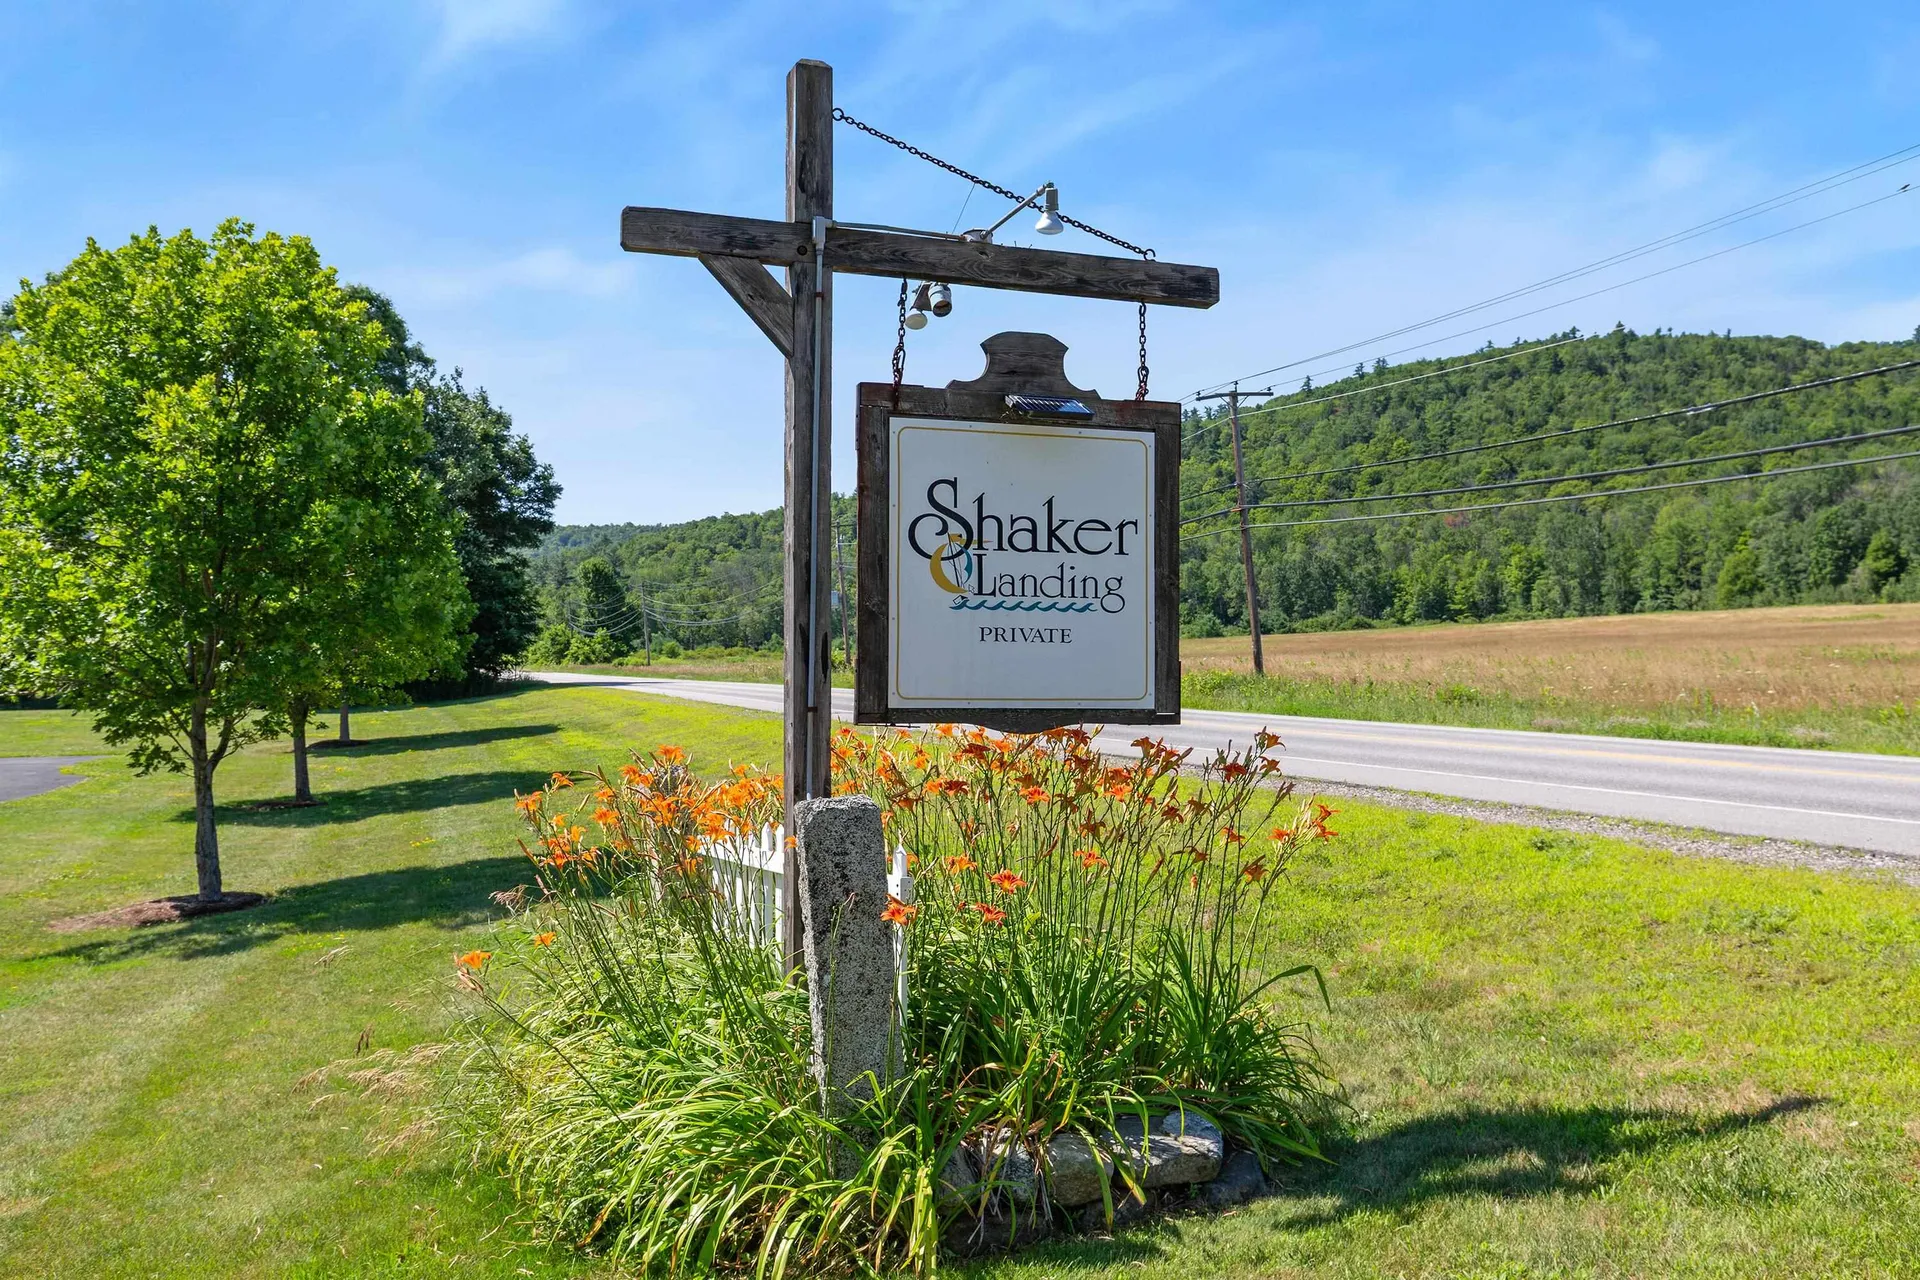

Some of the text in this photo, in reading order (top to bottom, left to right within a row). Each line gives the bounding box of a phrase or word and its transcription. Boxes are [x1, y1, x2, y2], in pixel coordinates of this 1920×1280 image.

[908, 477, 1138, 561] Shaker
[973, 553, 1125, 613] Landing
[979, 626, 1073, 643] PRIVATE
